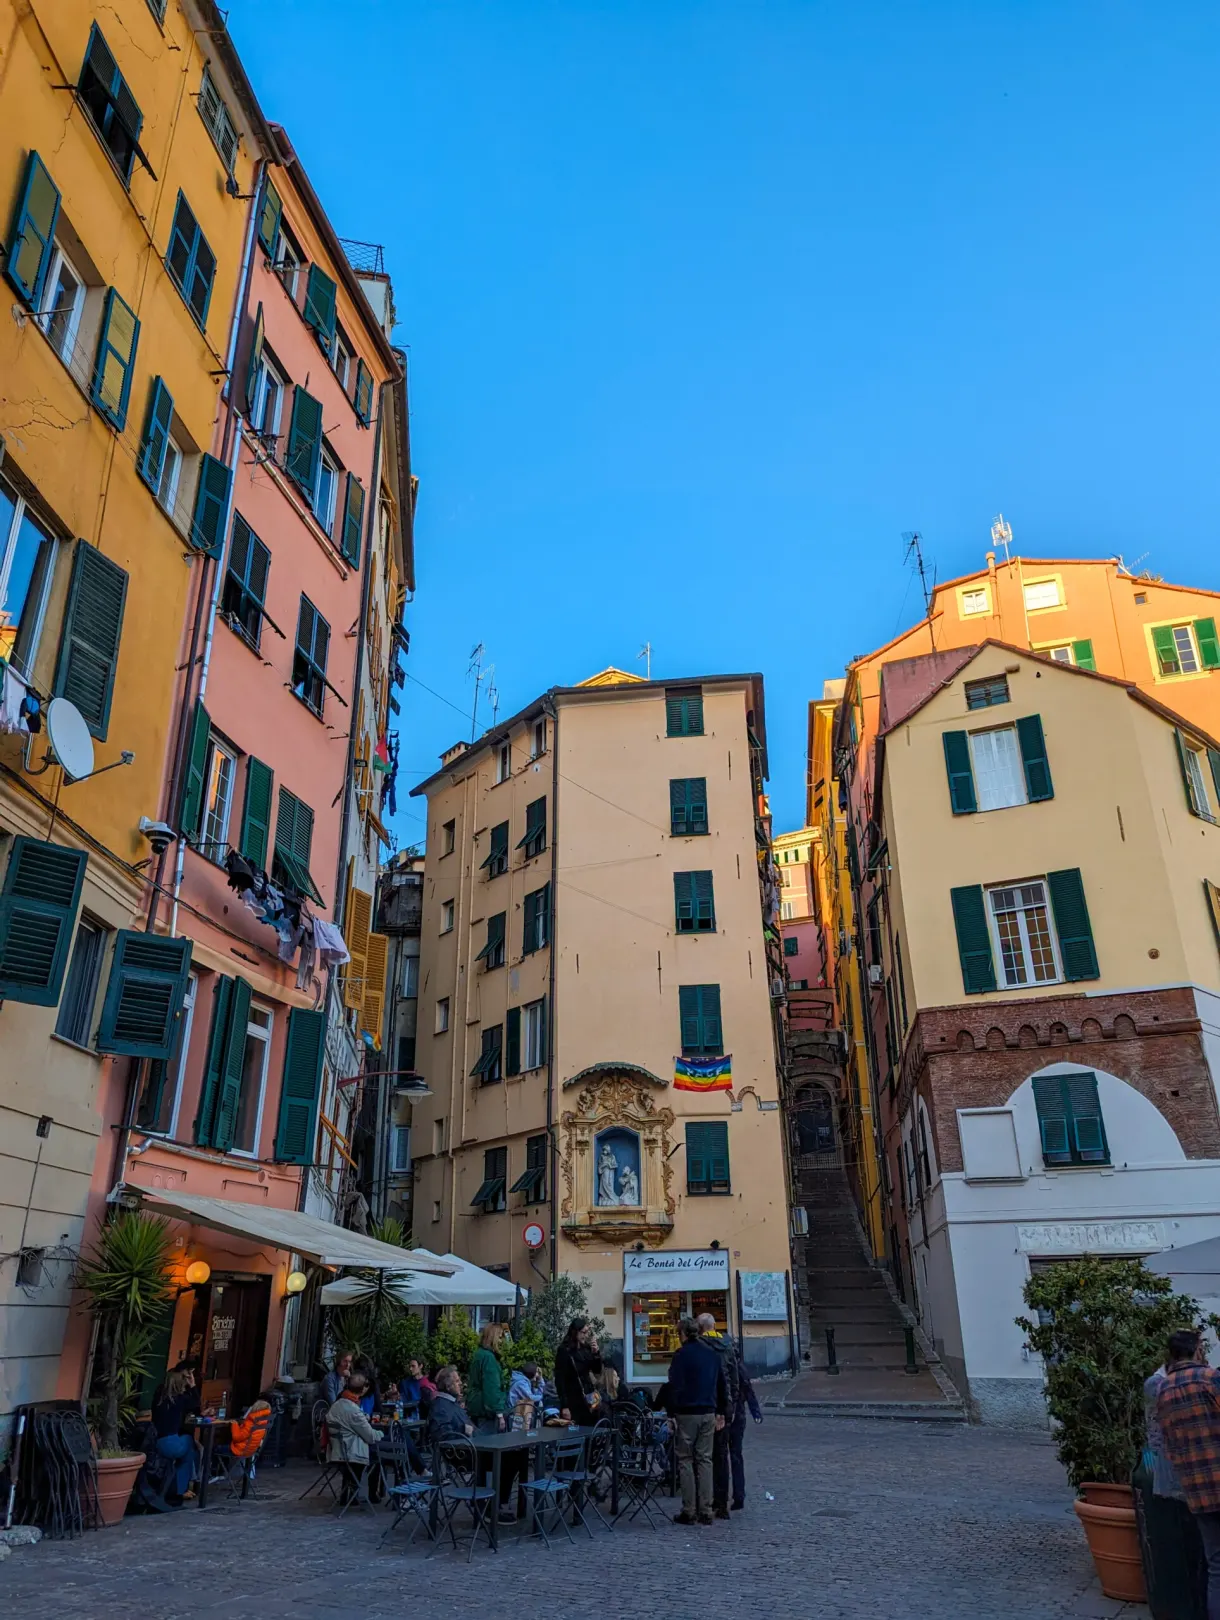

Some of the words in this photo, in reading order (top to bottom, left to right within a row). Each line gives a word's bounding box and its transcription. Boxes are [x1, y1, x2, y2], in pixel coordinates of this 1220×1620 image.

[629, 1257, 642, 1268] Le
[645, 1257, 675, 1268] Bontà
[678, 1257, 692, 1268] del
[693, 1256, 725, 1269] Grano
